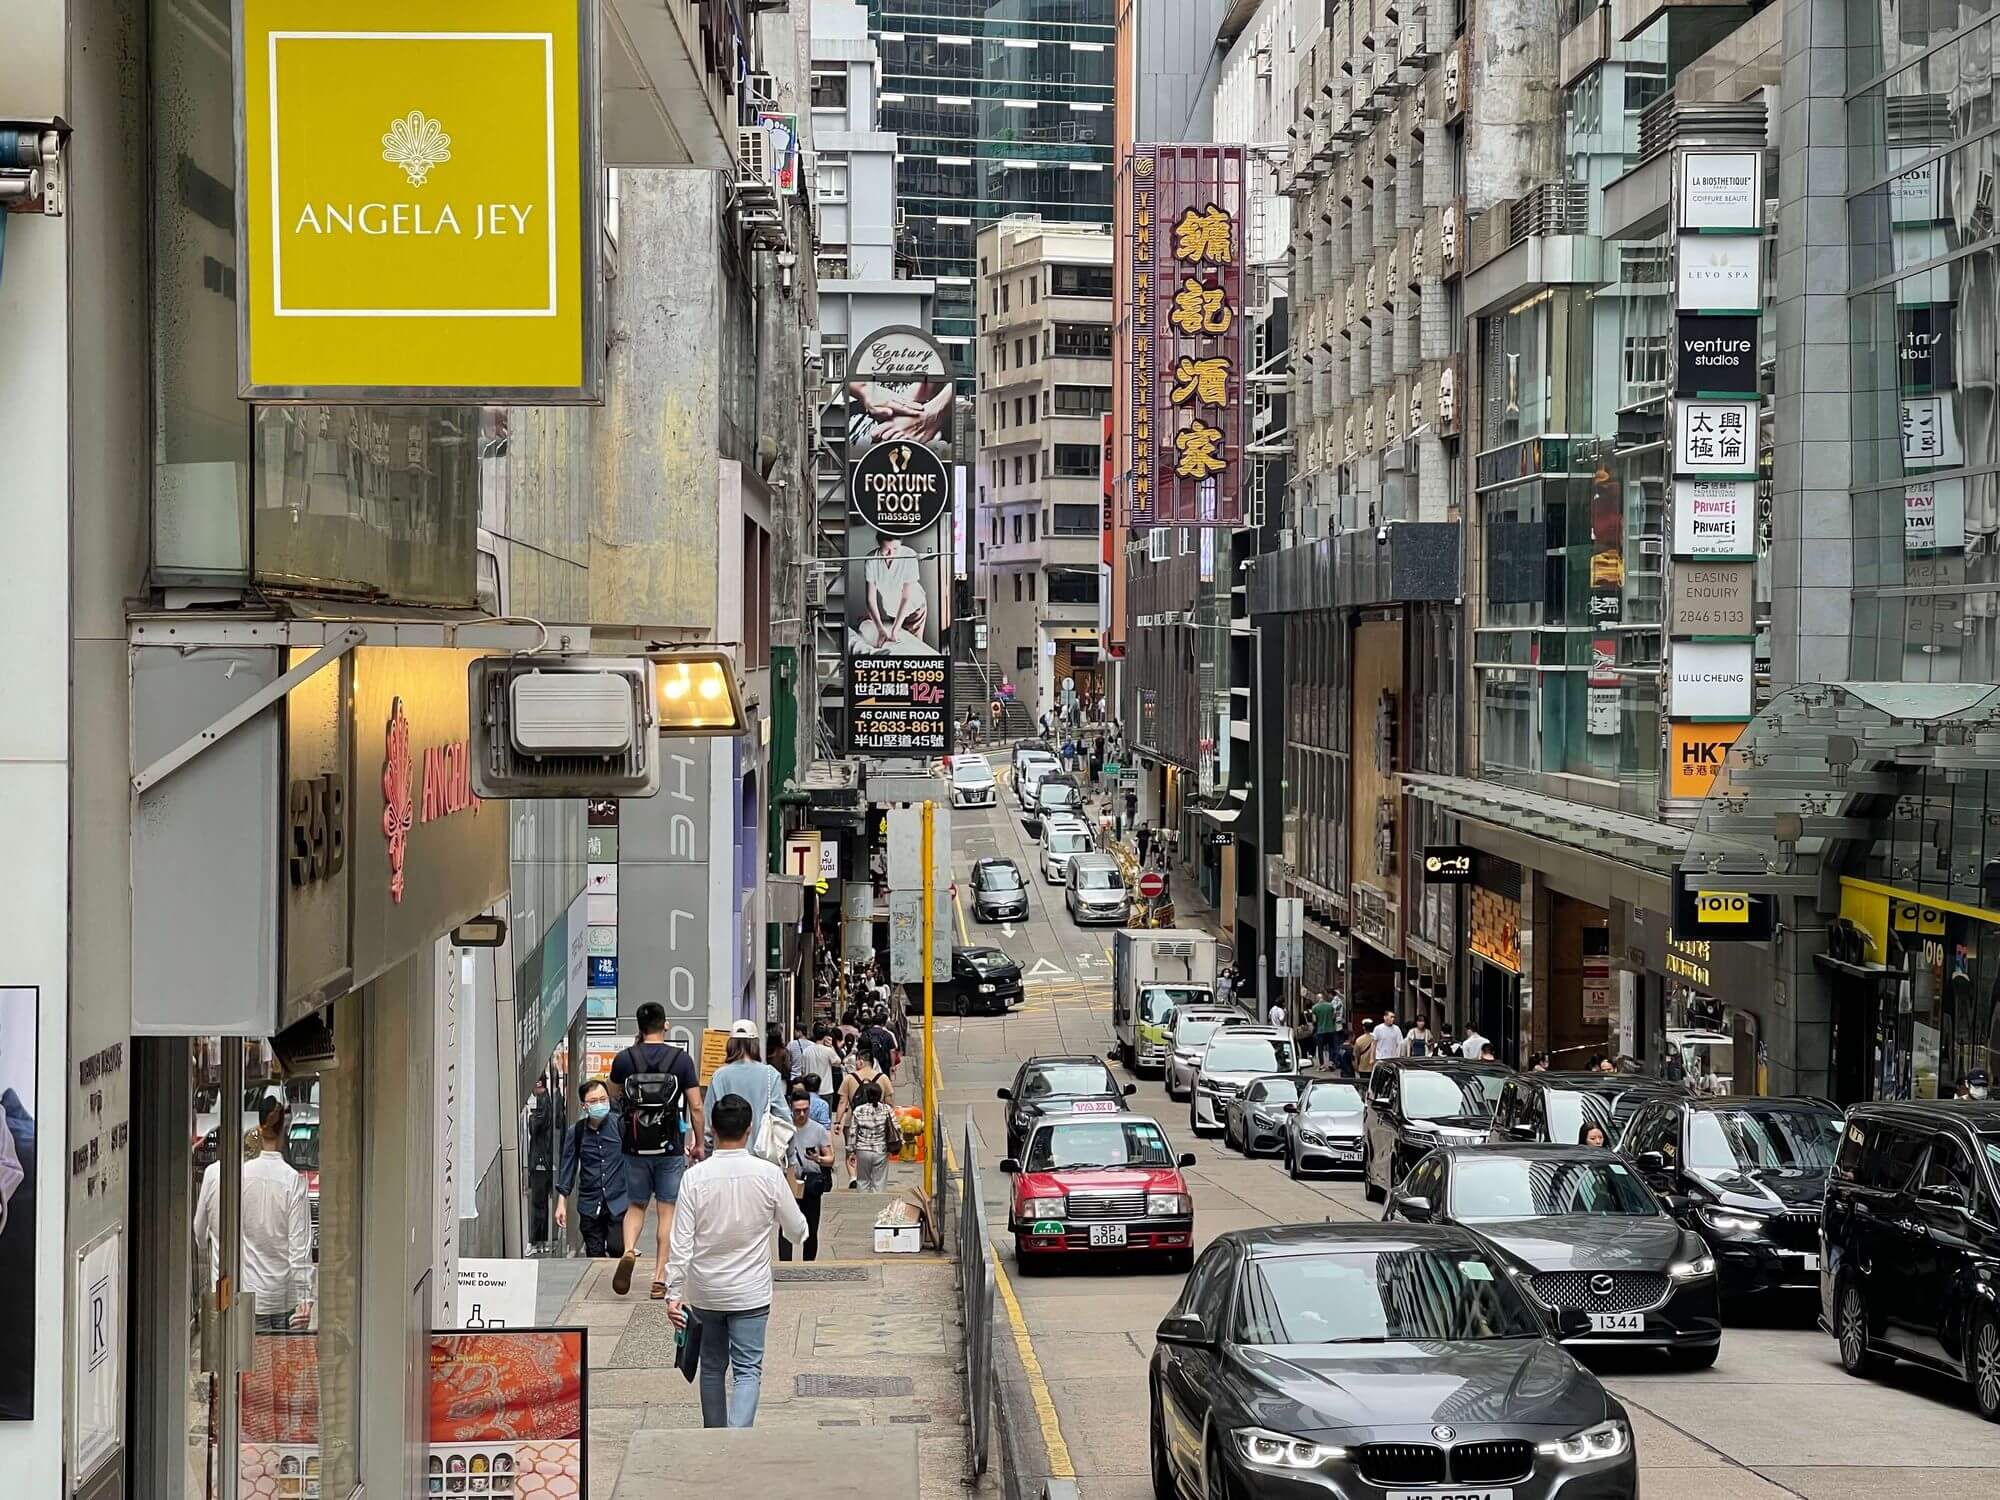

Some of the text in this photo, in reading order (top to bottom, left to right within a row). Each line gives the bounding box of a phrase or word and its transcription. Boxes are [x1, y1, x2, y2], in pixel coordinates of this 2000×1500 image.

[1692, 177, 1700, 186] LA
[295, 203, 533, 239] ANGELA JEY
[1688, 271, 1750, 279] LEVO SPA
[1172, 206, 1232, 478] 鏞記酒家
[1684, 337, 1751, 353] venture
[871, 343, 934, 364] Century
[1137, 191, 1149, 512] YUNG KEE RESTAURANT
[871, 357, 929, 374] Square
[1695, 354, 1740, 366] studios
[864, 473, 937, 493] FORTUNE
[877, 493, 922, 513] FOOT
[1693, 500, 1730, 514] PRIVATE
[877, 512, 921, 523] massage
[1693, 520, 1730, 535] PRIVATE
[1687, 572, 1738, 583] LEASING
[1686, 587, 1739, 598] ENQUIRY
[1679, 610, 1744, 622] 2846 5133
[854, 660, 945, 669] CENTURY SQUARE
[854, 670, 945, 682] T: 2115-1999
[1678, 674, 1744, 683] LU LU CHEUNG
[854, 682, 945, 704] 世紀廣場 12/F
[860, 711, 940, 720] 45 CAINE ROAD
[854, 720, 944, 733] T: 2633-8611
[1682, 742, 1735, 763] HKT
[420, 738, 476, 825] ANGEL
[670, 738, 696, 861] HE
[289, 772, 345, 887] 35B
[792, 846, 811, 876] T
[1701, 897, 1745, 911] 1010
[1075, 1102, 1114, 1111] TAXI
[1100, 1227, 1117, 1235] SP
[1093, 1235, 1125, 1245] 3084
[478, 1271, 489, 1279] TO
[478, 1280, 507, 1288] DOWN!
[92, 1296, 105, 1356] R
[1600, 1315, 1638, 1329] 1344
